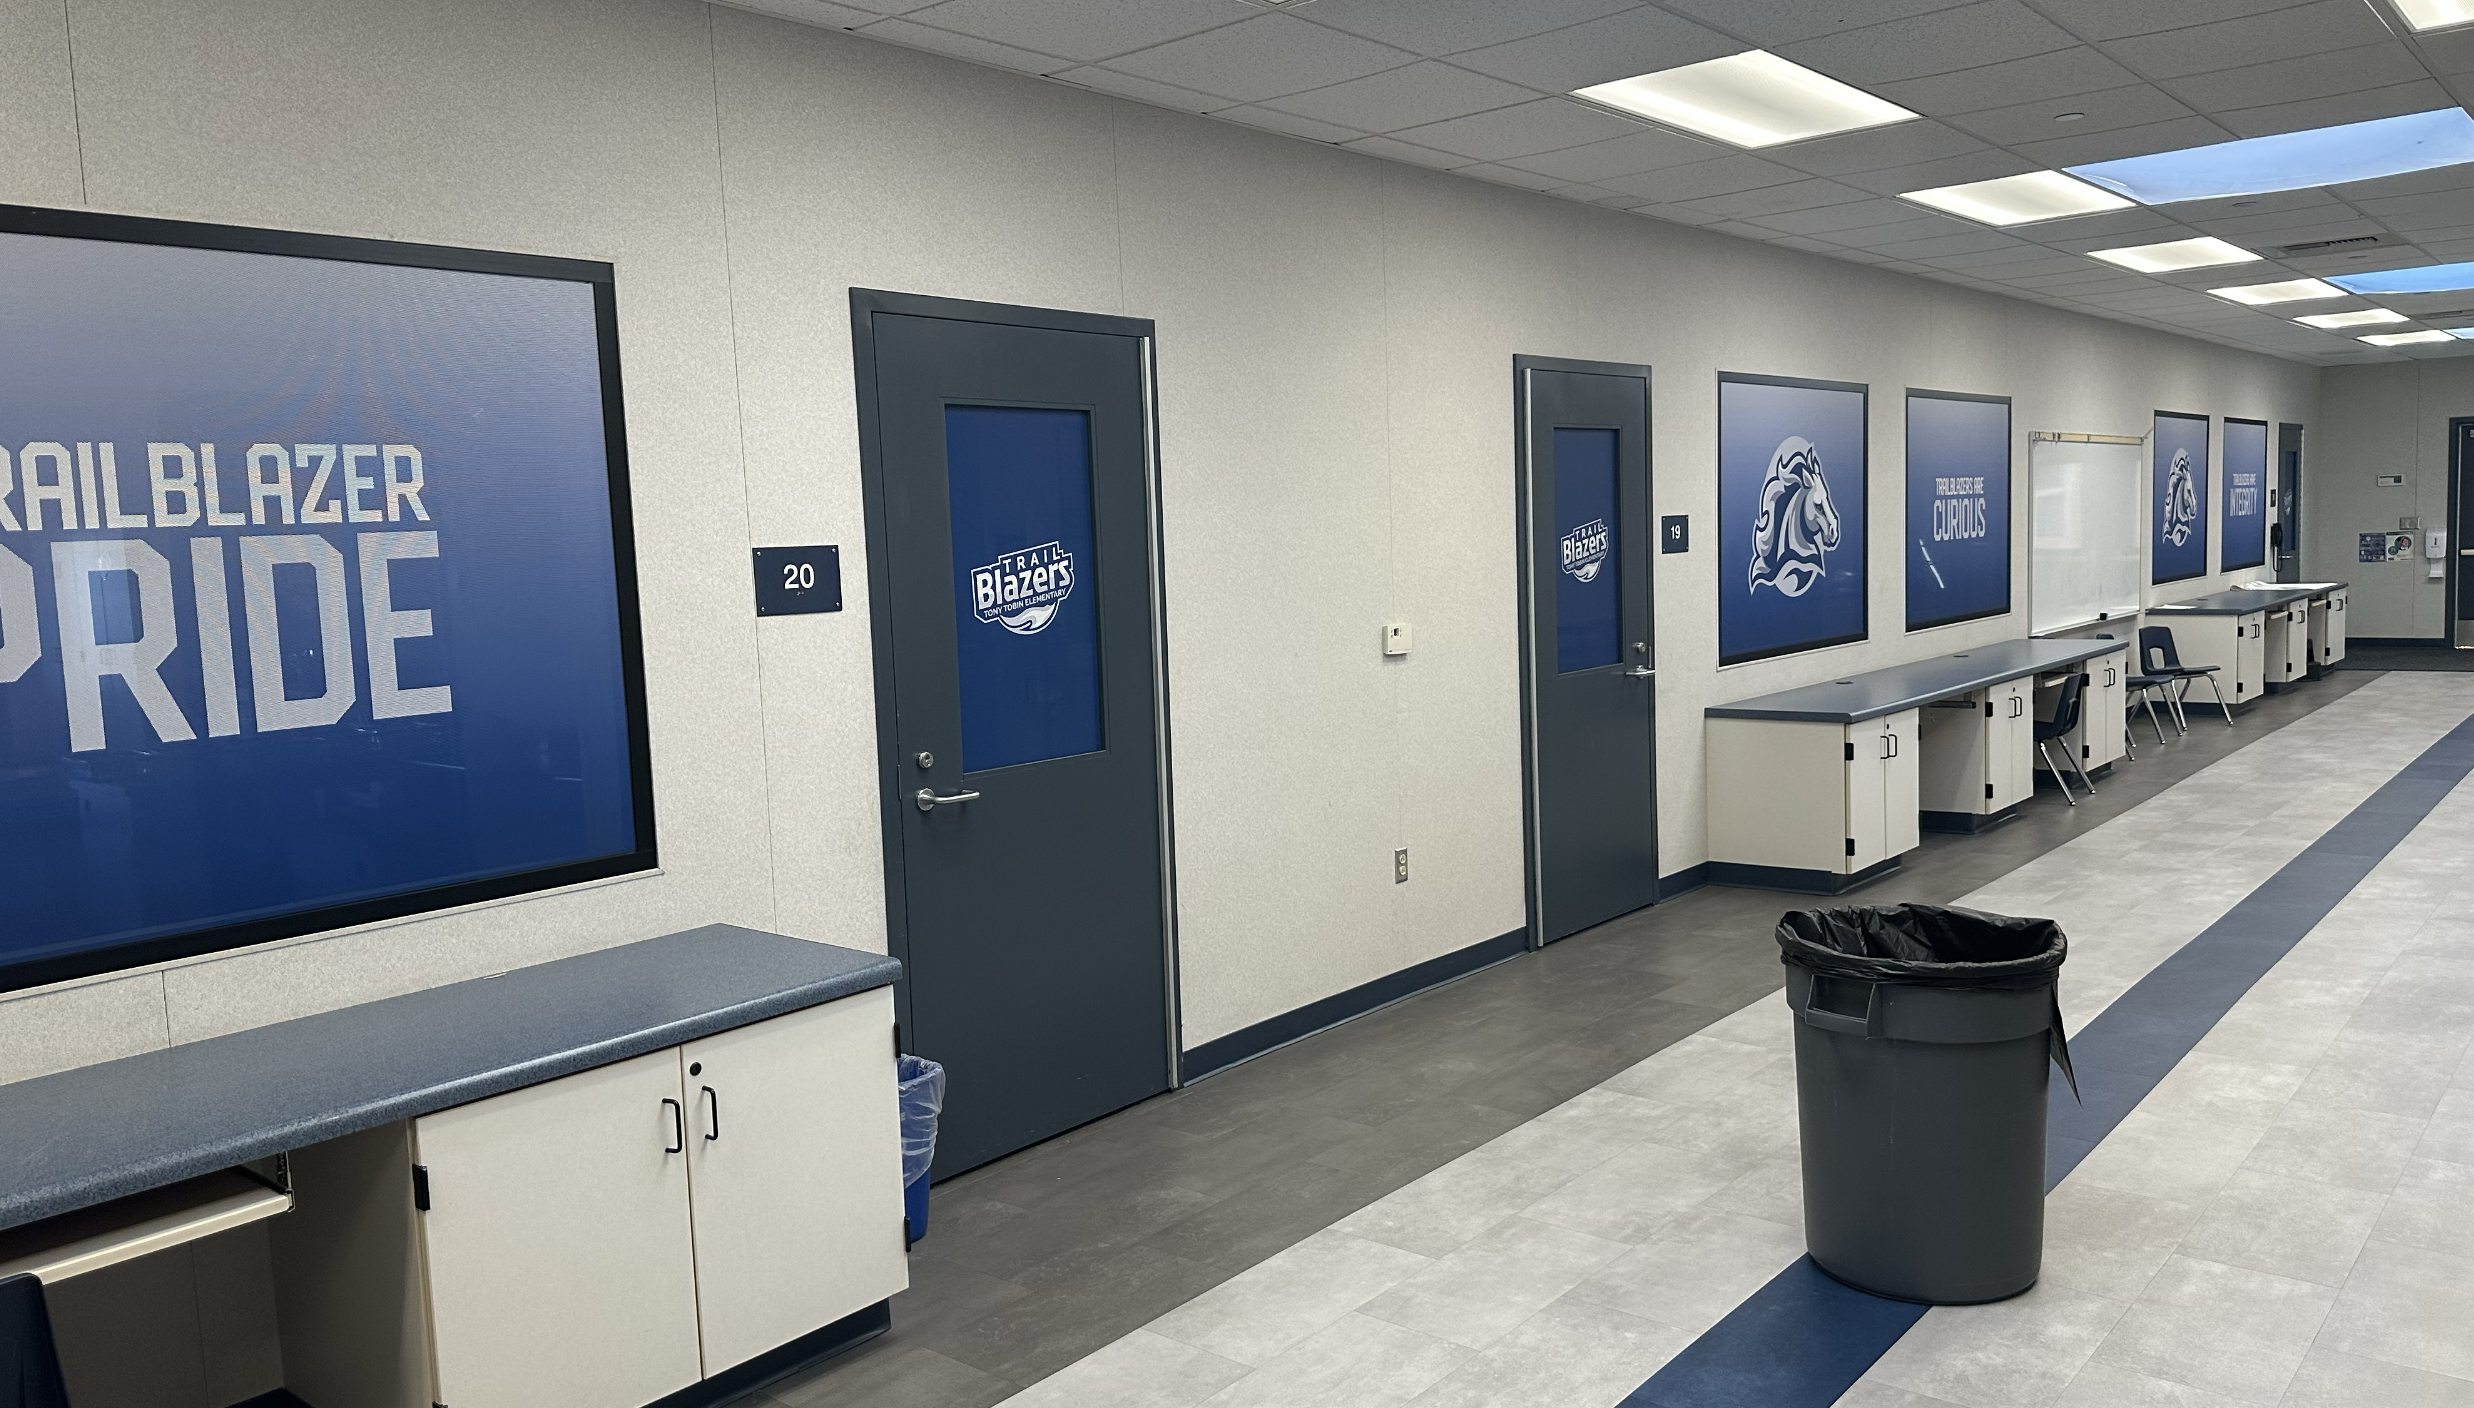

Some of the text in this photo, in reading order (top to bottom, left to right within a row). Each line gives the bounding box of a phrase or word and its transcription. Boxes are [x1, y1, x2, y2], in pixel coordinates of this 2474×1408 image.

[1936, 477, 1984, 495] TRAILBLAZERS ARE
[2230, 488, 2257, 516] INTEGRITY
[1575, 522, 1603, 540] TRAIL
[1670, 524, 1681, 540] 19
[1934, 498, 1985, 541] CURIOUS
[1003, 547, 1060, 572] TRAIL
[1562, 531, 1607, 565] Blazers
[783, 563, 815, 590] 20
[976, 559, 1071, 610] Blazers
[984, 588, 1066, 618] TONY TOBIN ELEMENTARY
